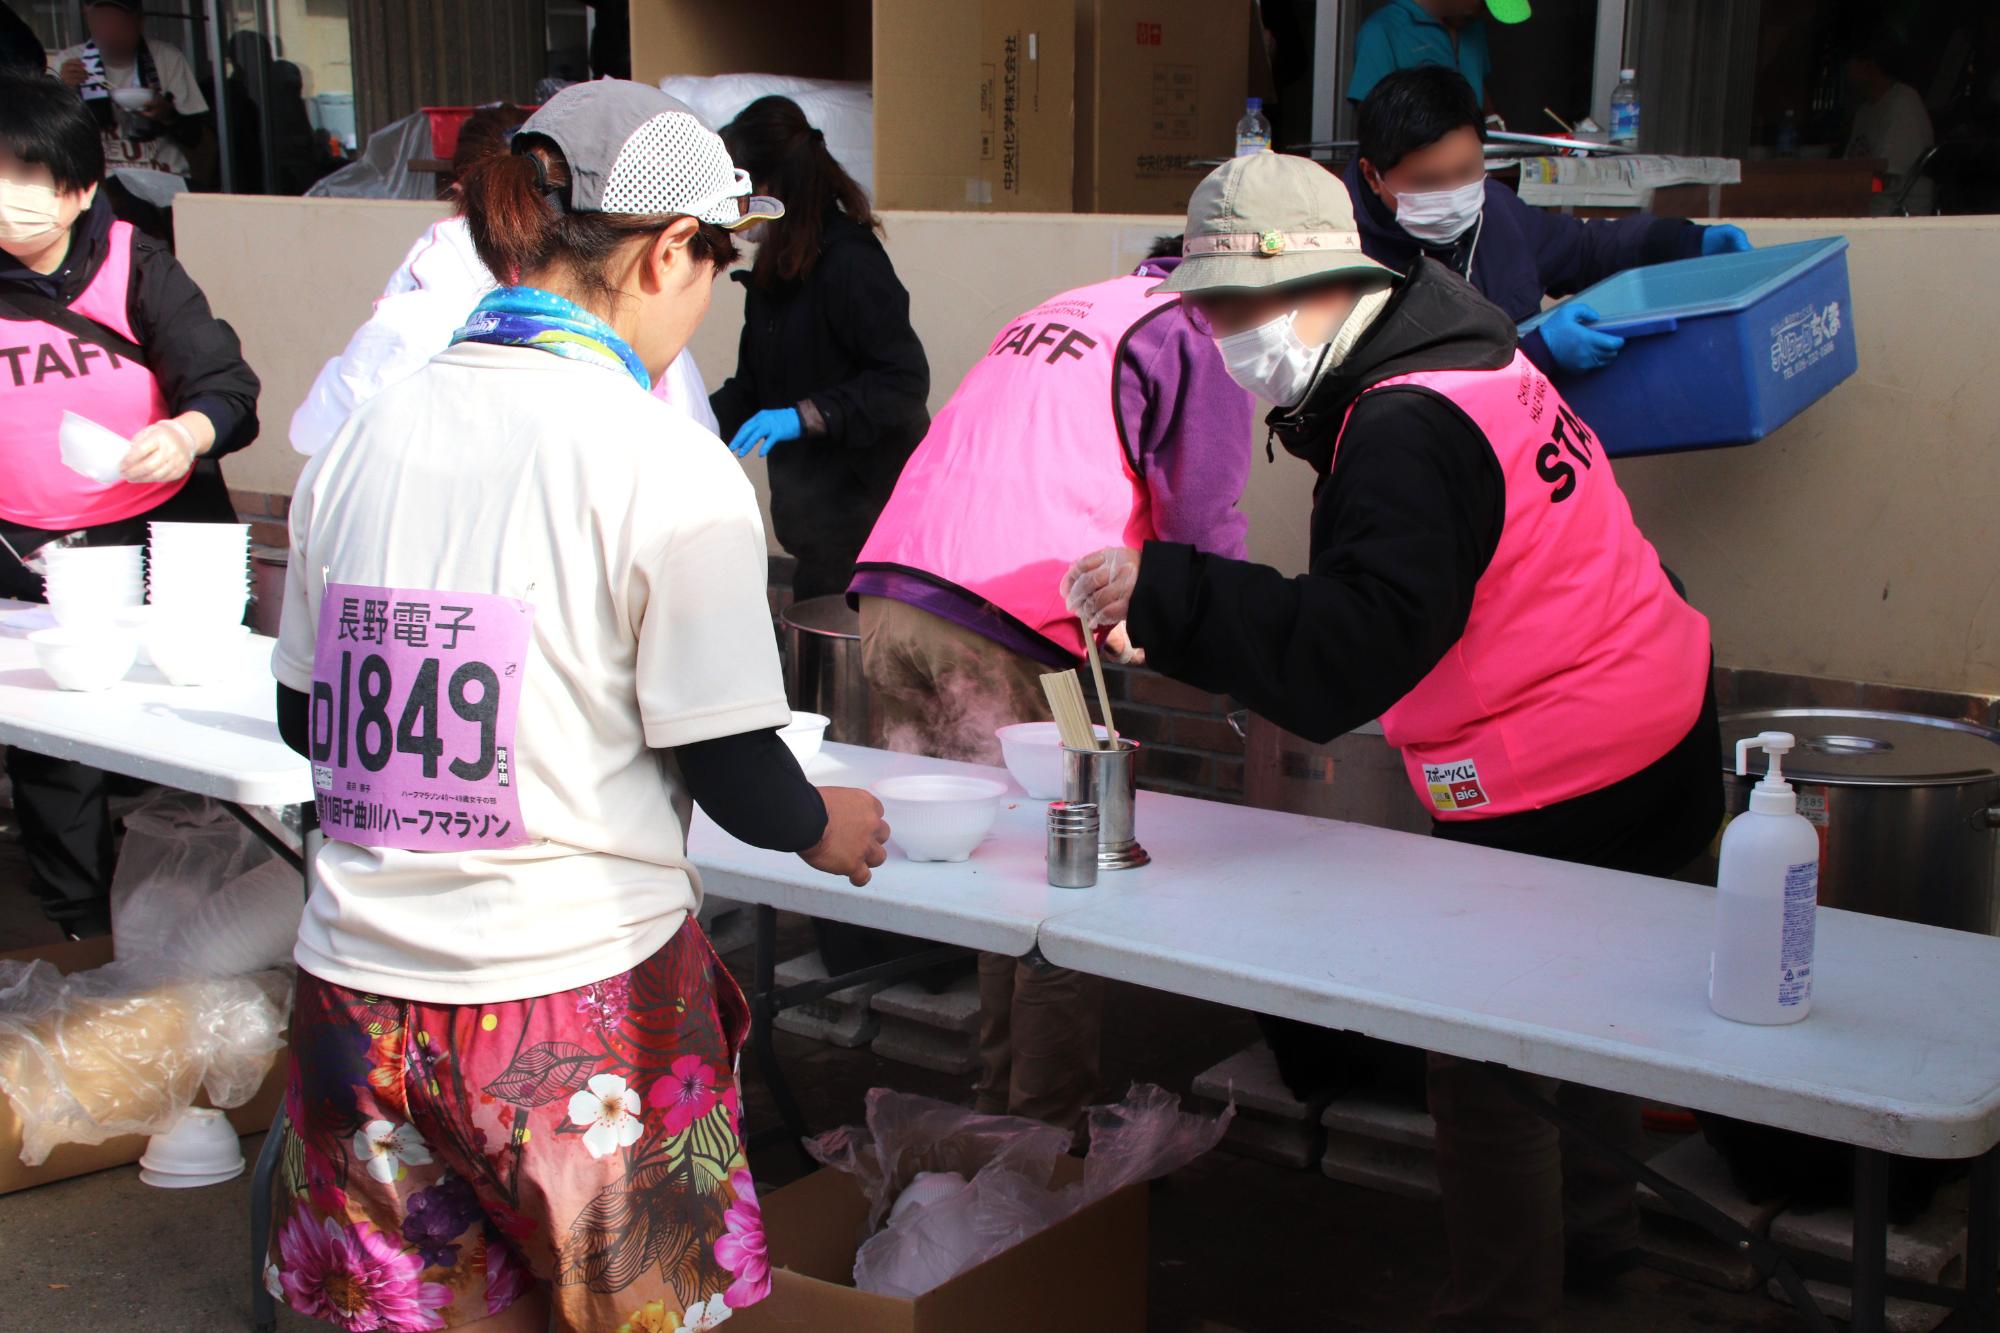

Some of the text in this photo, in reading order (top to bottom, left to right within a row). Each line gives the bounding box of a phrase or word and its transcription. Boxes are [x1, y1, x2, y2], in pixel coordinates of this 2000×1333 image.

[1003, 35, 1017, 190] 中央化学株式会社
[338, 597, 476, 650] 長野電子
[1425, 764, 1476, 782] スポーツくじ
